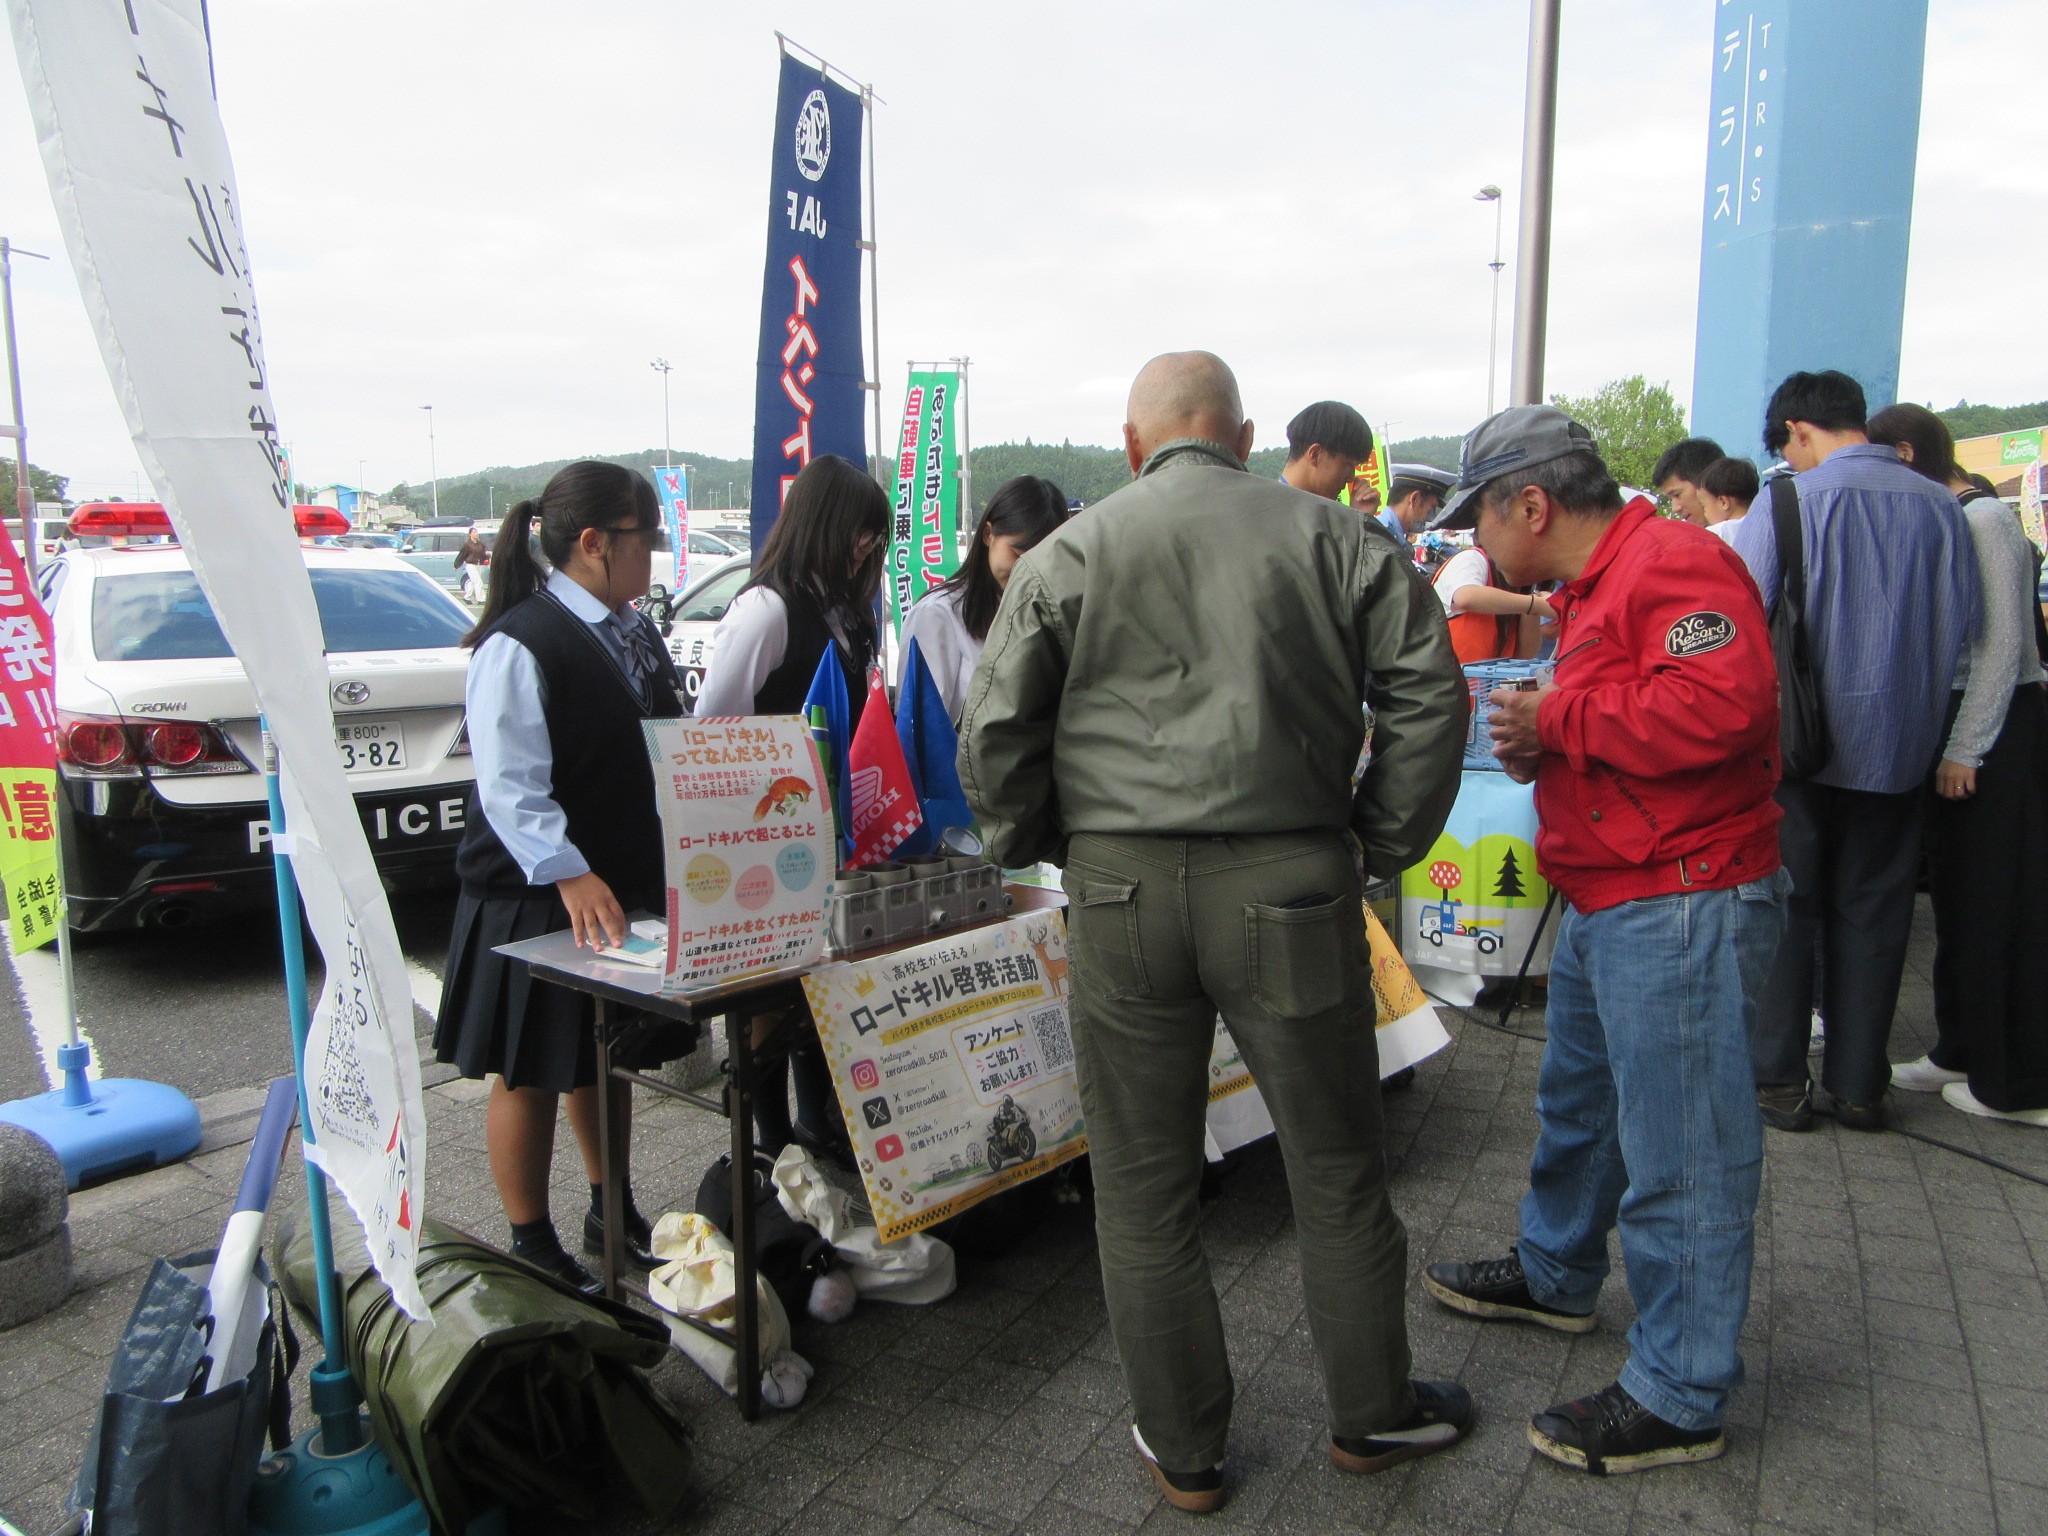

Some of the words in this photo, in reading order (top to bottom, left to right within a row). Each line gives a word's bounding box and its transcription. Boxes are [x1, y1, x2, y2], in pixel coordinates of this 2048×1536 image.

[1713, 0, 1741, 221] テラス
[1668, 620, 1727, 652] Record
[1682, 633, 1725, 652] BREAKERS
[670, 638, 705, 666] 奈良
[131, 700, 188, 713] CROWN
[354, 725, 380, 740] 800
[681, 727, 777, 747] 「ロードキル」
[671, 742, 794, 766] ってなんだろう?
[674, 778, 762, 793] 亡くなってしまうこと。
[249, 797, 466, 854] PICE
[679, 822, 816, 851] ロードキルで起こること
[682, 909, 822, 944] ロードキルをなくすために
[891, 946, 970, 982] 高校生が伝える
[1414, 949, 1433, 960] JAF
[850, 953, 1040, 1038] ロードキル啓発活動
[891, 987, 1035, 1041] バイク好き高校生によるロードキル啓発プロジェクト
[963, 1018, 1025, 1052] アンケート
[885, 1048, 949, 1079] zeroroadkill_5026
[985, 1046, 1021, 1069] ご協力
[979, 1060, 1039, 1093] お願いします!
[896, 1089, 948, 1116] @zeroroadkill
[905, 1122, 934, 1140] YouTube
